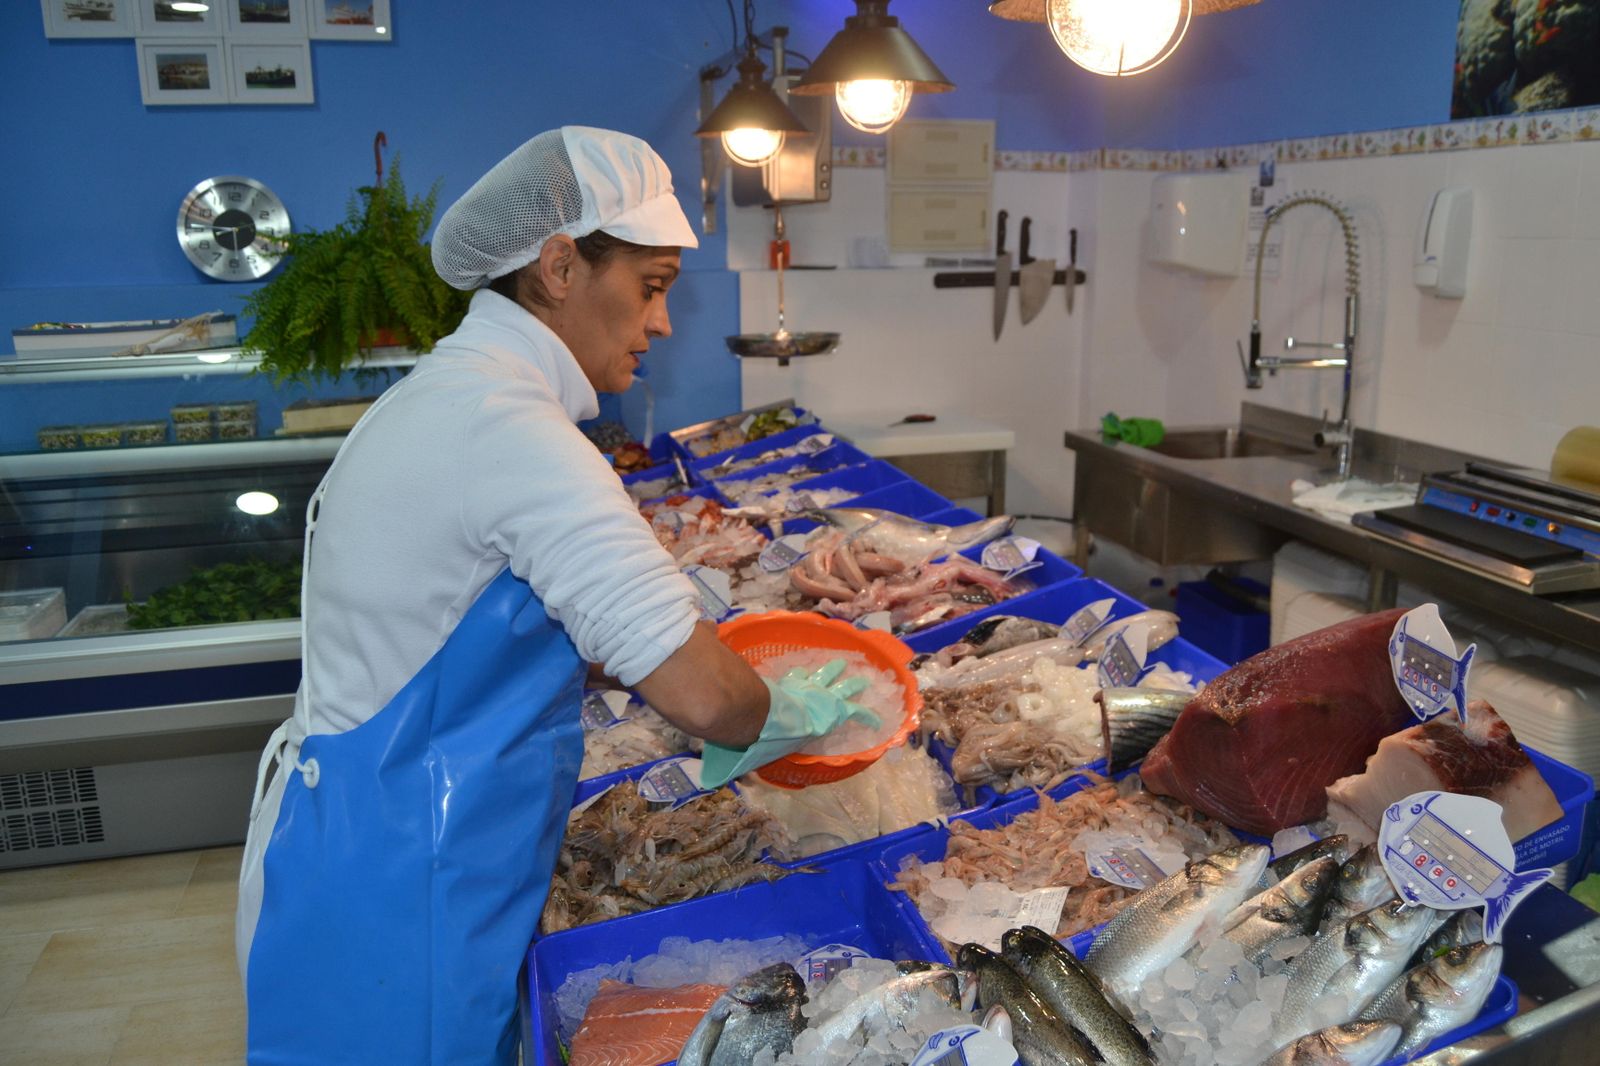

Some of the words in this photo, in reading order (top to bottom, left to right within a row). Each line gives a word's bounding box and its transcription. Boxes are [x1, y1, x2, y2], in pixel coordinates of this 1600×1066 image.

[228, 192, 242, 202] 12
[199, 208, 212, 218] 10
[259, 210, 270, 219] 2
[199, 241, 210, 250] 8
[261, 243, 270, 252] 4
[211, 252, 223, 262] 7
[246, 254, 257, 264] 5
[229, 258, 240, 269] 6
[1524, 840, 1534, 849] DE
[1534, 824, 1571, 845] ENVASADO
[1529, 847, 1538, 855] DE
[1539, 835, 1565, 850] MOTRIL
